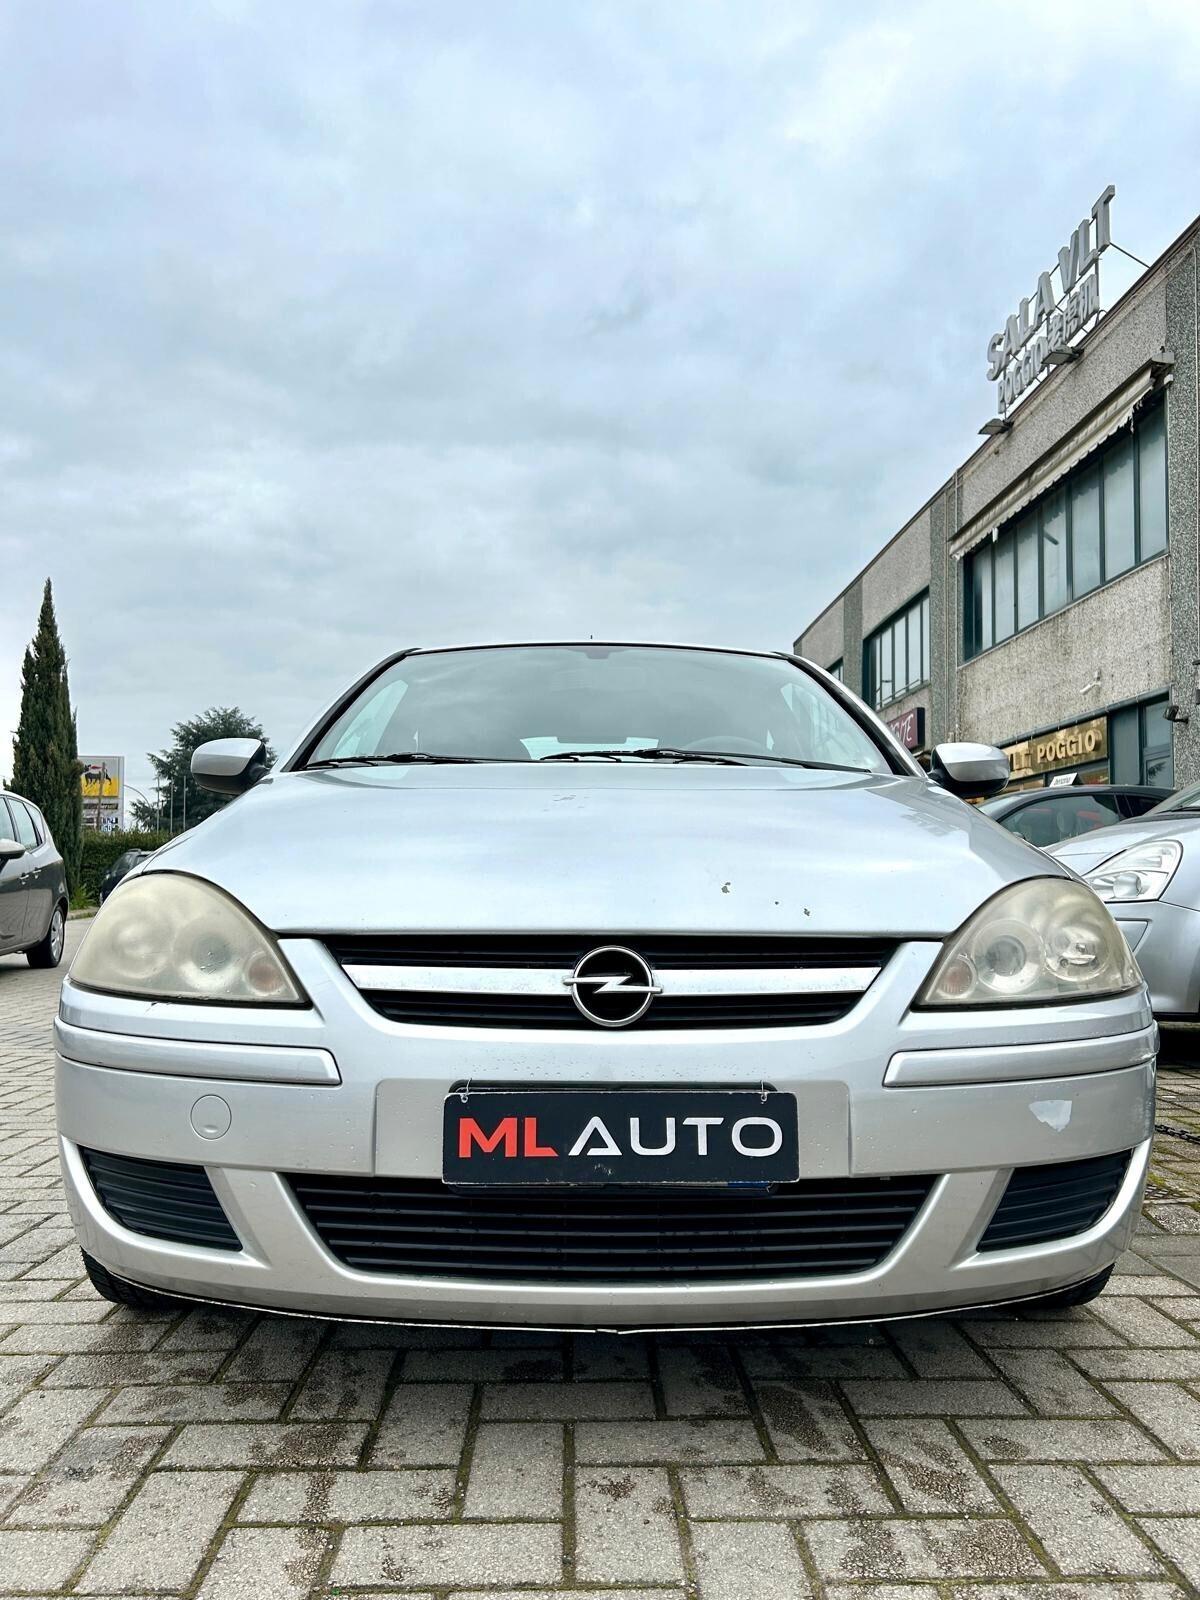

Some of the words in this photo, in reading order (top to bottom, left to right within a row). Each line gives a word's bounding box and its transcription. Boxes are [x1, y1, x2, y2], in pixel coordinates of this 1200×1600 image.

[986, 271, 1055, 381] SALA
[1058, 184, 1115, 294] VLT
[998, 336, 1049, 414] POGGIO
[1037, 730, 1096, 764] POGGIO
[458, 1117, 559, 1158] ML
[568, 1116, 783, 1158] AUTO
